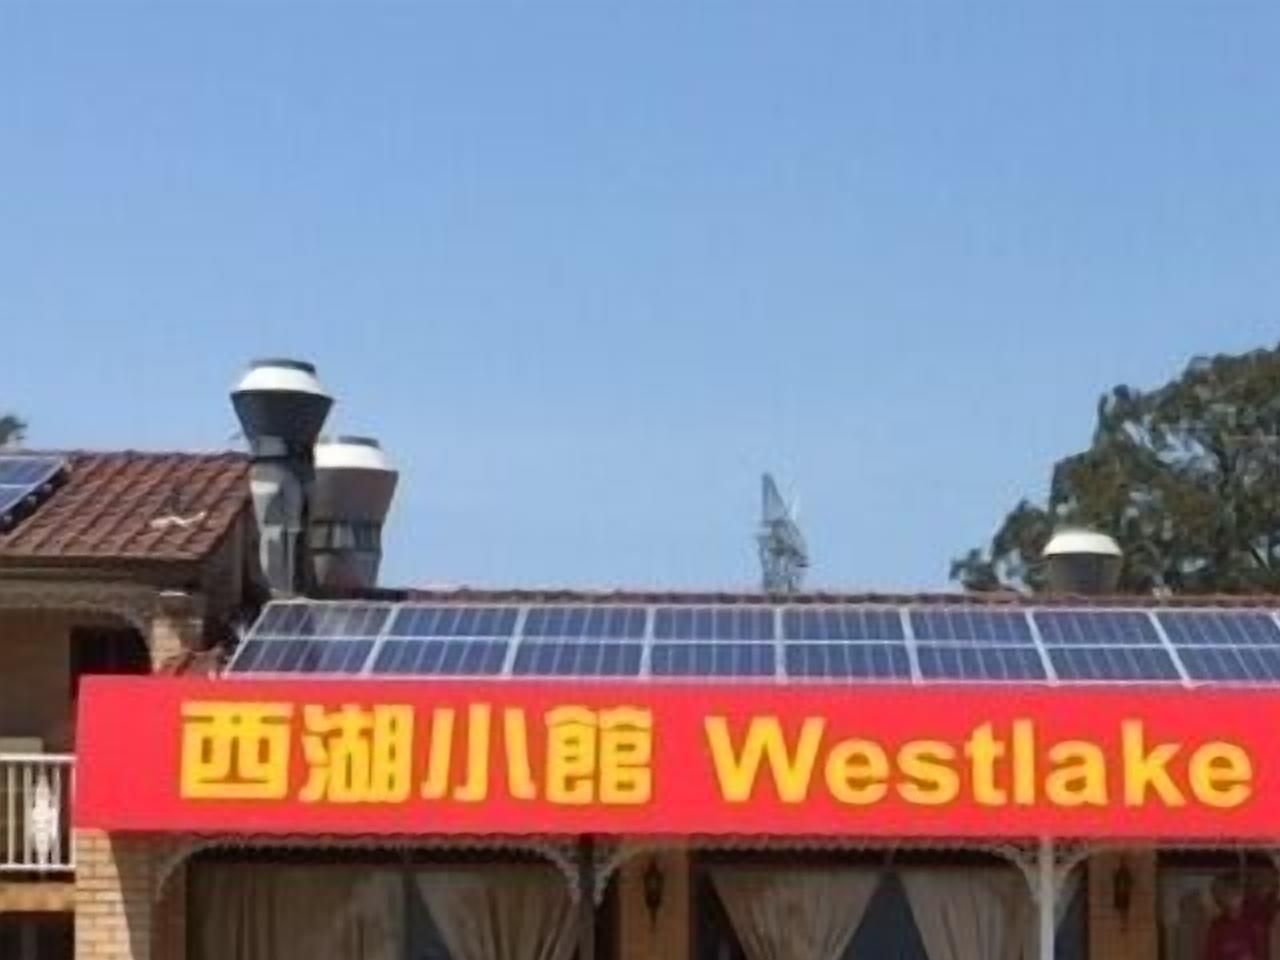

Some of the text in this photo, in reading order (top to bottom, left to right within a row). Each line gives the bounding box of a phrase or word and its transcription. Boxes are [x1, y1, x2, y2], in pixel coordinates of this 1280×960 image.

[179, 700, 654, 804] 西湖小館
[704, 716, 1253, 808] Westlake
